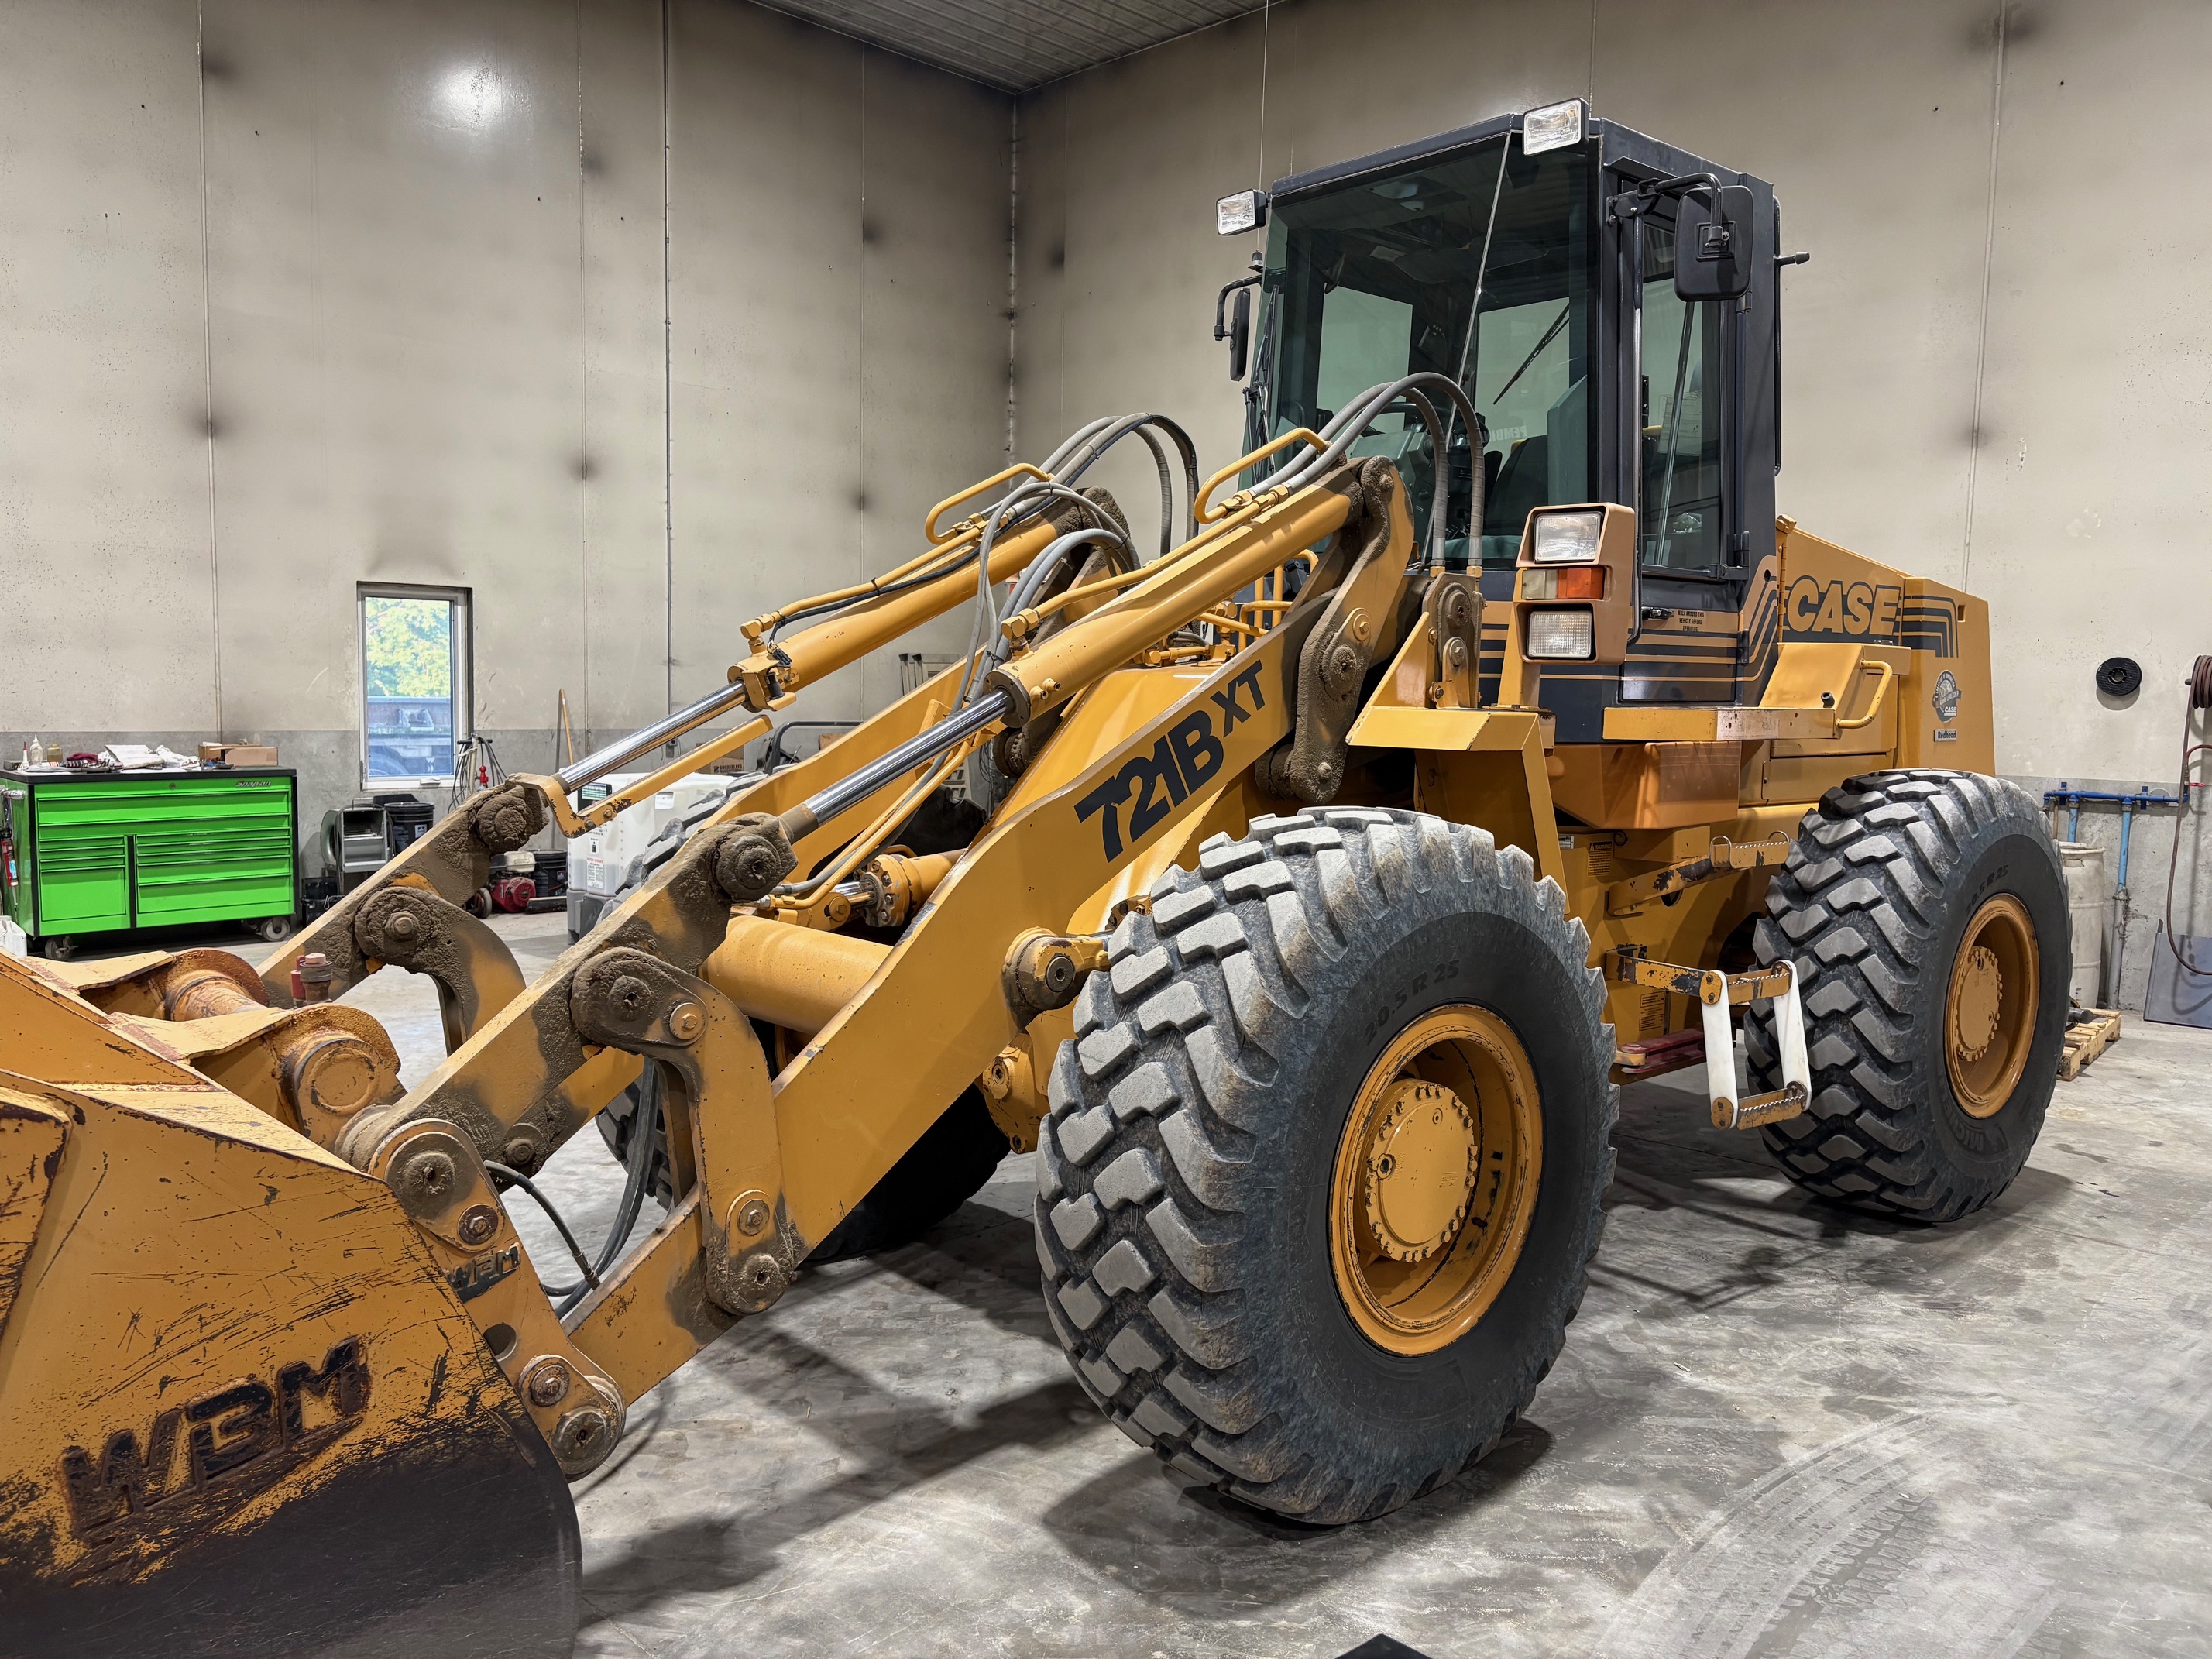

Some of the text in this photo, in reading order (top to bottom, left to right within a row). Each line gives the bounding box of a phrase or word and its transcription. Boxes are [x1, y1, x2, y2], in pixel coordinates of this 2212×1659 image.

[1786, 576, 1901, 635] CASE
[1073, 660, 1265, 863] 721B XT
[1987, 872, 1995, 888] R
[1996, 864, 2009, 880] 25
[1364, 959, 1460, 1046] 20.5 R 25
[443, 1242, 521, 1293] WBM
[57, 1336, 371, 1533] WBM
